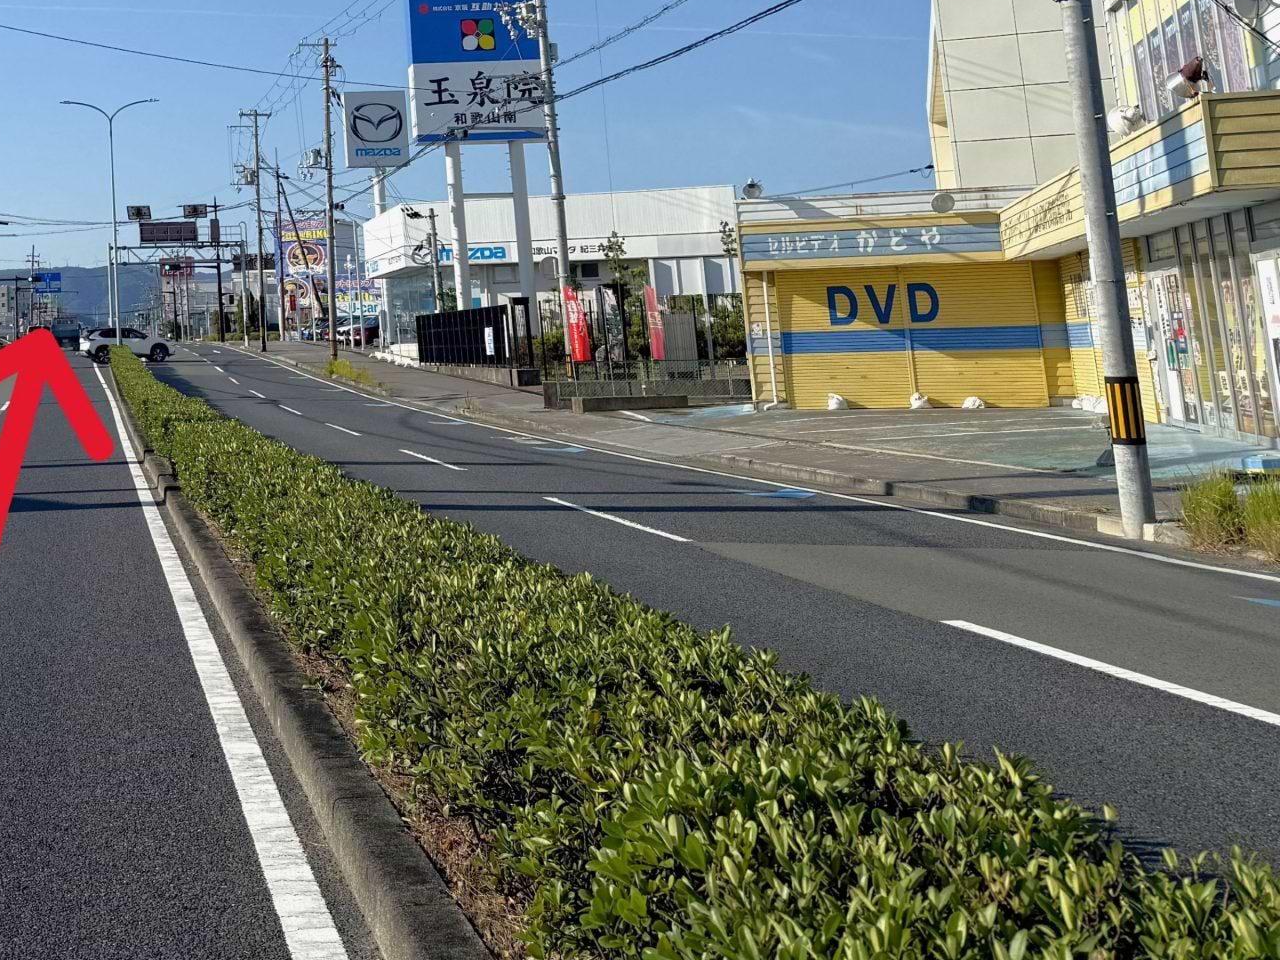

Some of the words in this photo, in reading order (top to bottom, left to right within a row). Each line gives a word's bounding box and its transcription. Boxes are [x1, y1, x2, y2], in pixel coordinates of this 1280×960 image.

[424, 71, 545, 107] 玉泉院
[454, 112, 517, 125] 和歌山南
[856, 227, 941, 253] かどや
[438, 246, 506, 261] mzda
[826, 282, 940, 326] DVD
